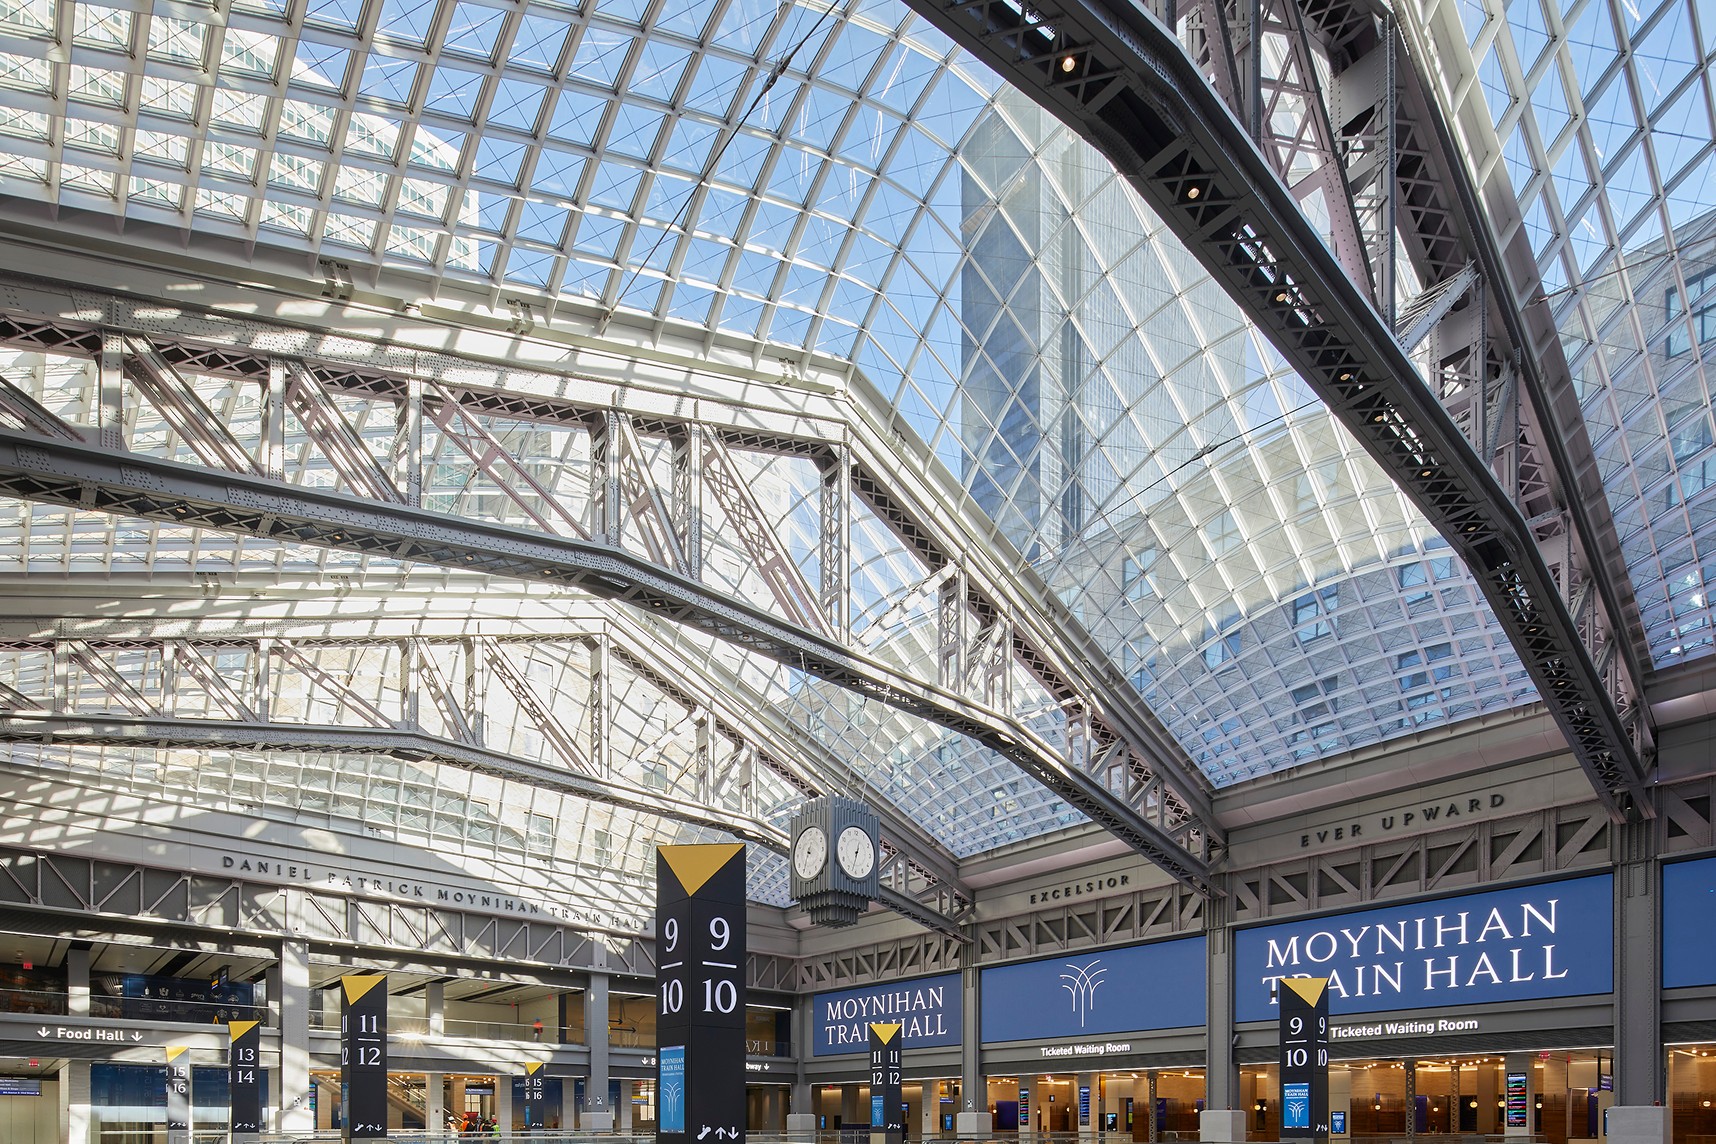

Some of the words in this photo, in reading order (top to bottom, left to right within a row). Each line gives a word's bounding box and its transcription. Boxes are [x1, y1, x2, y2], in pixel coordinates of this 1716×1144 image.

[1301, 824, 1362, 847] EVER
[1382, 794, 1504, 830] UPWARD
[223, 856, 312, 880] DANIEL
[328, 872, 423, 897] PATRICK
[437, 889, 539, 914] MOYNIHAN
[550, 906, 600, 923] TRAIN
[611, 916, 650, 931] HALL
[1030, 875, 1129, 904] EXCELSIOR
[664, 917, 679, 952] 9
[709, 917, 730, 951] 9
[1266, 899, 1559, 968] MOYNIHAN
[1423, 944, 1568, 990] HALL
[661, 978, 684, 1015] 10
[702, 978, 737, 1014] 10
[826, 986, 944, 1021] MOYNIHAN
[360, 1014, 378, 1033] 11
[825, 1020, 885, 1045] TRAI
[1290, 1016, 1303, 1035] 9
[1319, 1016, 1326, 1035] 9
[1330, 1025, 1382, 1038] Ticketed
[1385, 1022, 1435, 1035] Waiting
[1438, 1019, 1478, 1032] Room
[57, 1027, 92, 1040] Food
[96, 1029, 125, 1041] Hall
[239, 1048, 254, 1061] 13
[358, 1046, 381, 1066] 12
[873, 1050, 881, 1063] 11
[890, 1050, 899, 1063] 11
[1041, 1045, 1073, 1057] Ticketed
[1074, 1043, 1105, 1055] Waiting
[1106, 1043, 1131, 1053] Room
[1286, 1048, 1308, 1067] 10
[1317, 1048, 1328, 1067] 10
[173, 1066, 186, 1077] 15
[237, 1070, 255, 1083] 14
[872, 1072, 883, 1085] 12
[889, 1072, 900, 1085] 12
[173, 1083, 187, 1094] 16
[533, 1078, 542, 1087] 15
[533, 1091, 543, 1100] 16
